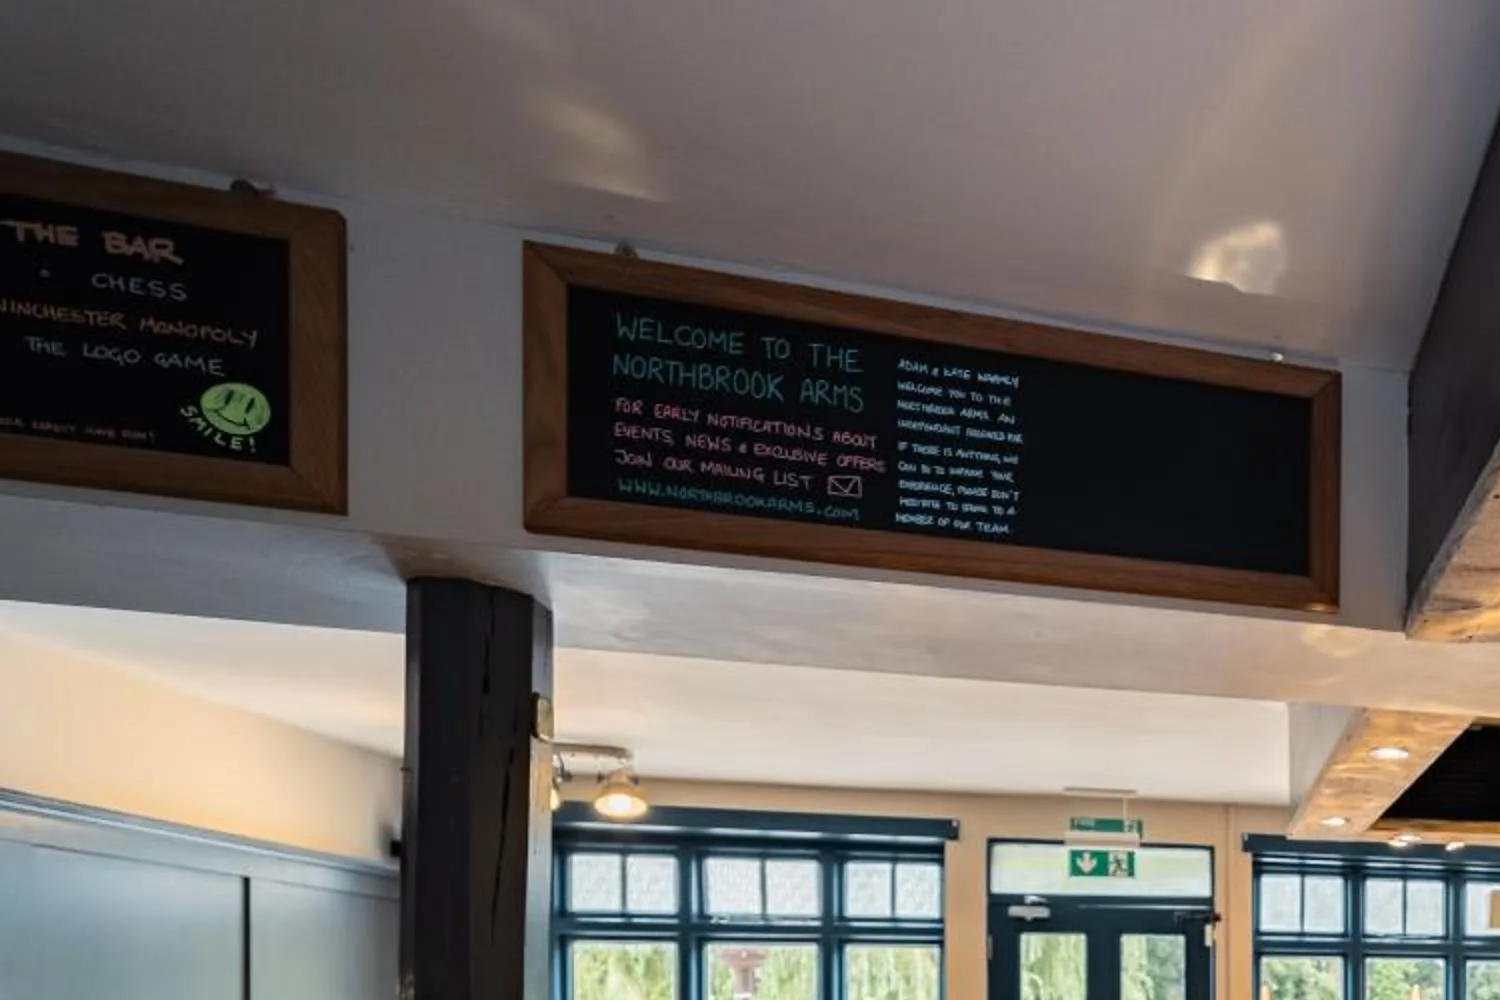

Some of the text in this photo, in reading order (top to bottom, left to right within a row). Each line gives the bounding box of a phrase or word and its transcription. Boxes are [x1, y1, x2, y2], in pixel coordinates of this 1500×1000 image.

[1, 220, 184, 265] THE BAR
[91, 272, 188, 302] CHESS
[138, 316, 259, 349] MONOPOLY
[615, 313, 864, 373] WELCOME TO THE
[24, 335, 225, 377] THE LOGO GAME
[613, 353, 864, 414] NORTHBROOK ARMS
[179, 404, 257, 453] SMILE!
[614, 397, 879, 449] FOR EARLY NOTIFICATIONS ABOUT
[614, 450, 815, 490] JOIN OUR MAILING LIST
[685, 434, 732, 453] NEWS
[753, 442, 829, 466] EXCLUSIVE
[836, 455, 887, 474] OFFERS
